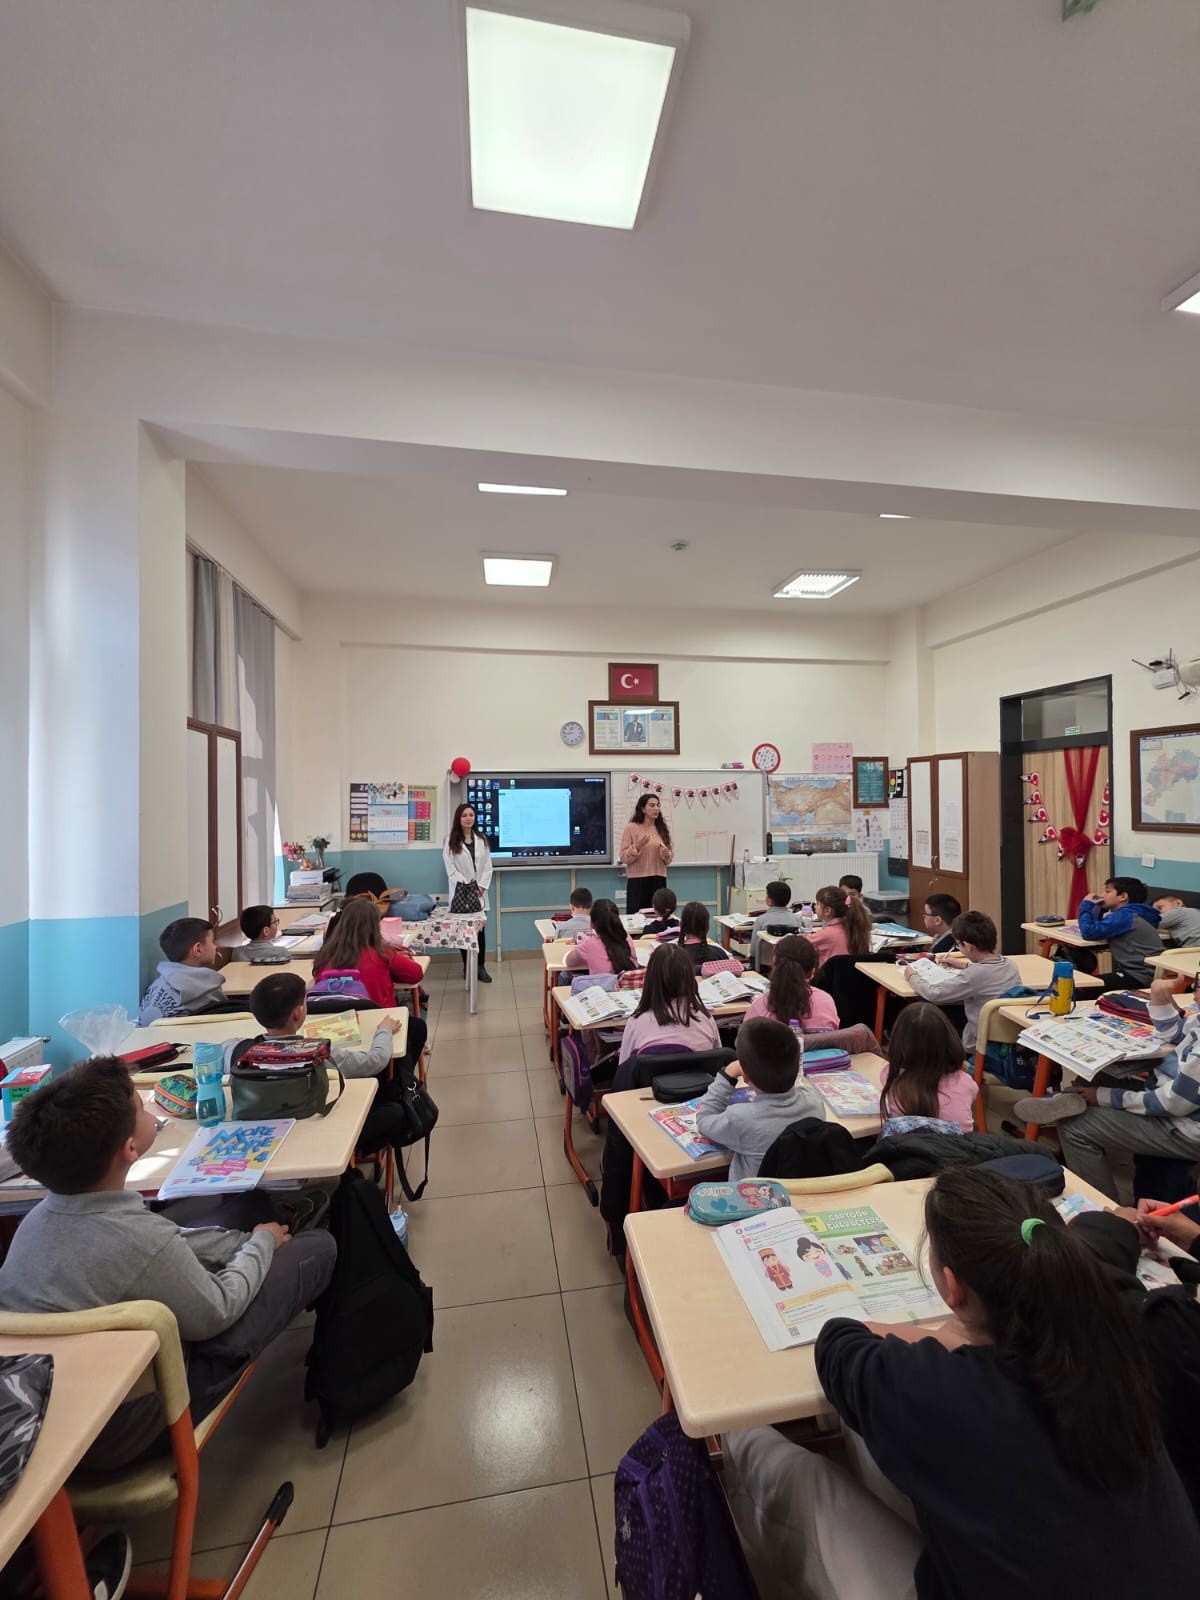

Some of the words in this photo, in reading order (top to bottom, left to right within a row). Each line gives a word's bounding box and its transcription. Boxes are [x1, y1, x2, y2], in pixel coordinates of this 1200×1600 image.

[206, 1127, 276, 1147] MORE
[206, 1136, 275, 1154] MORE
[826, 1216, 882, 1230] CHARACTERS
[828, 1210, 869, 1221] CARTOON
